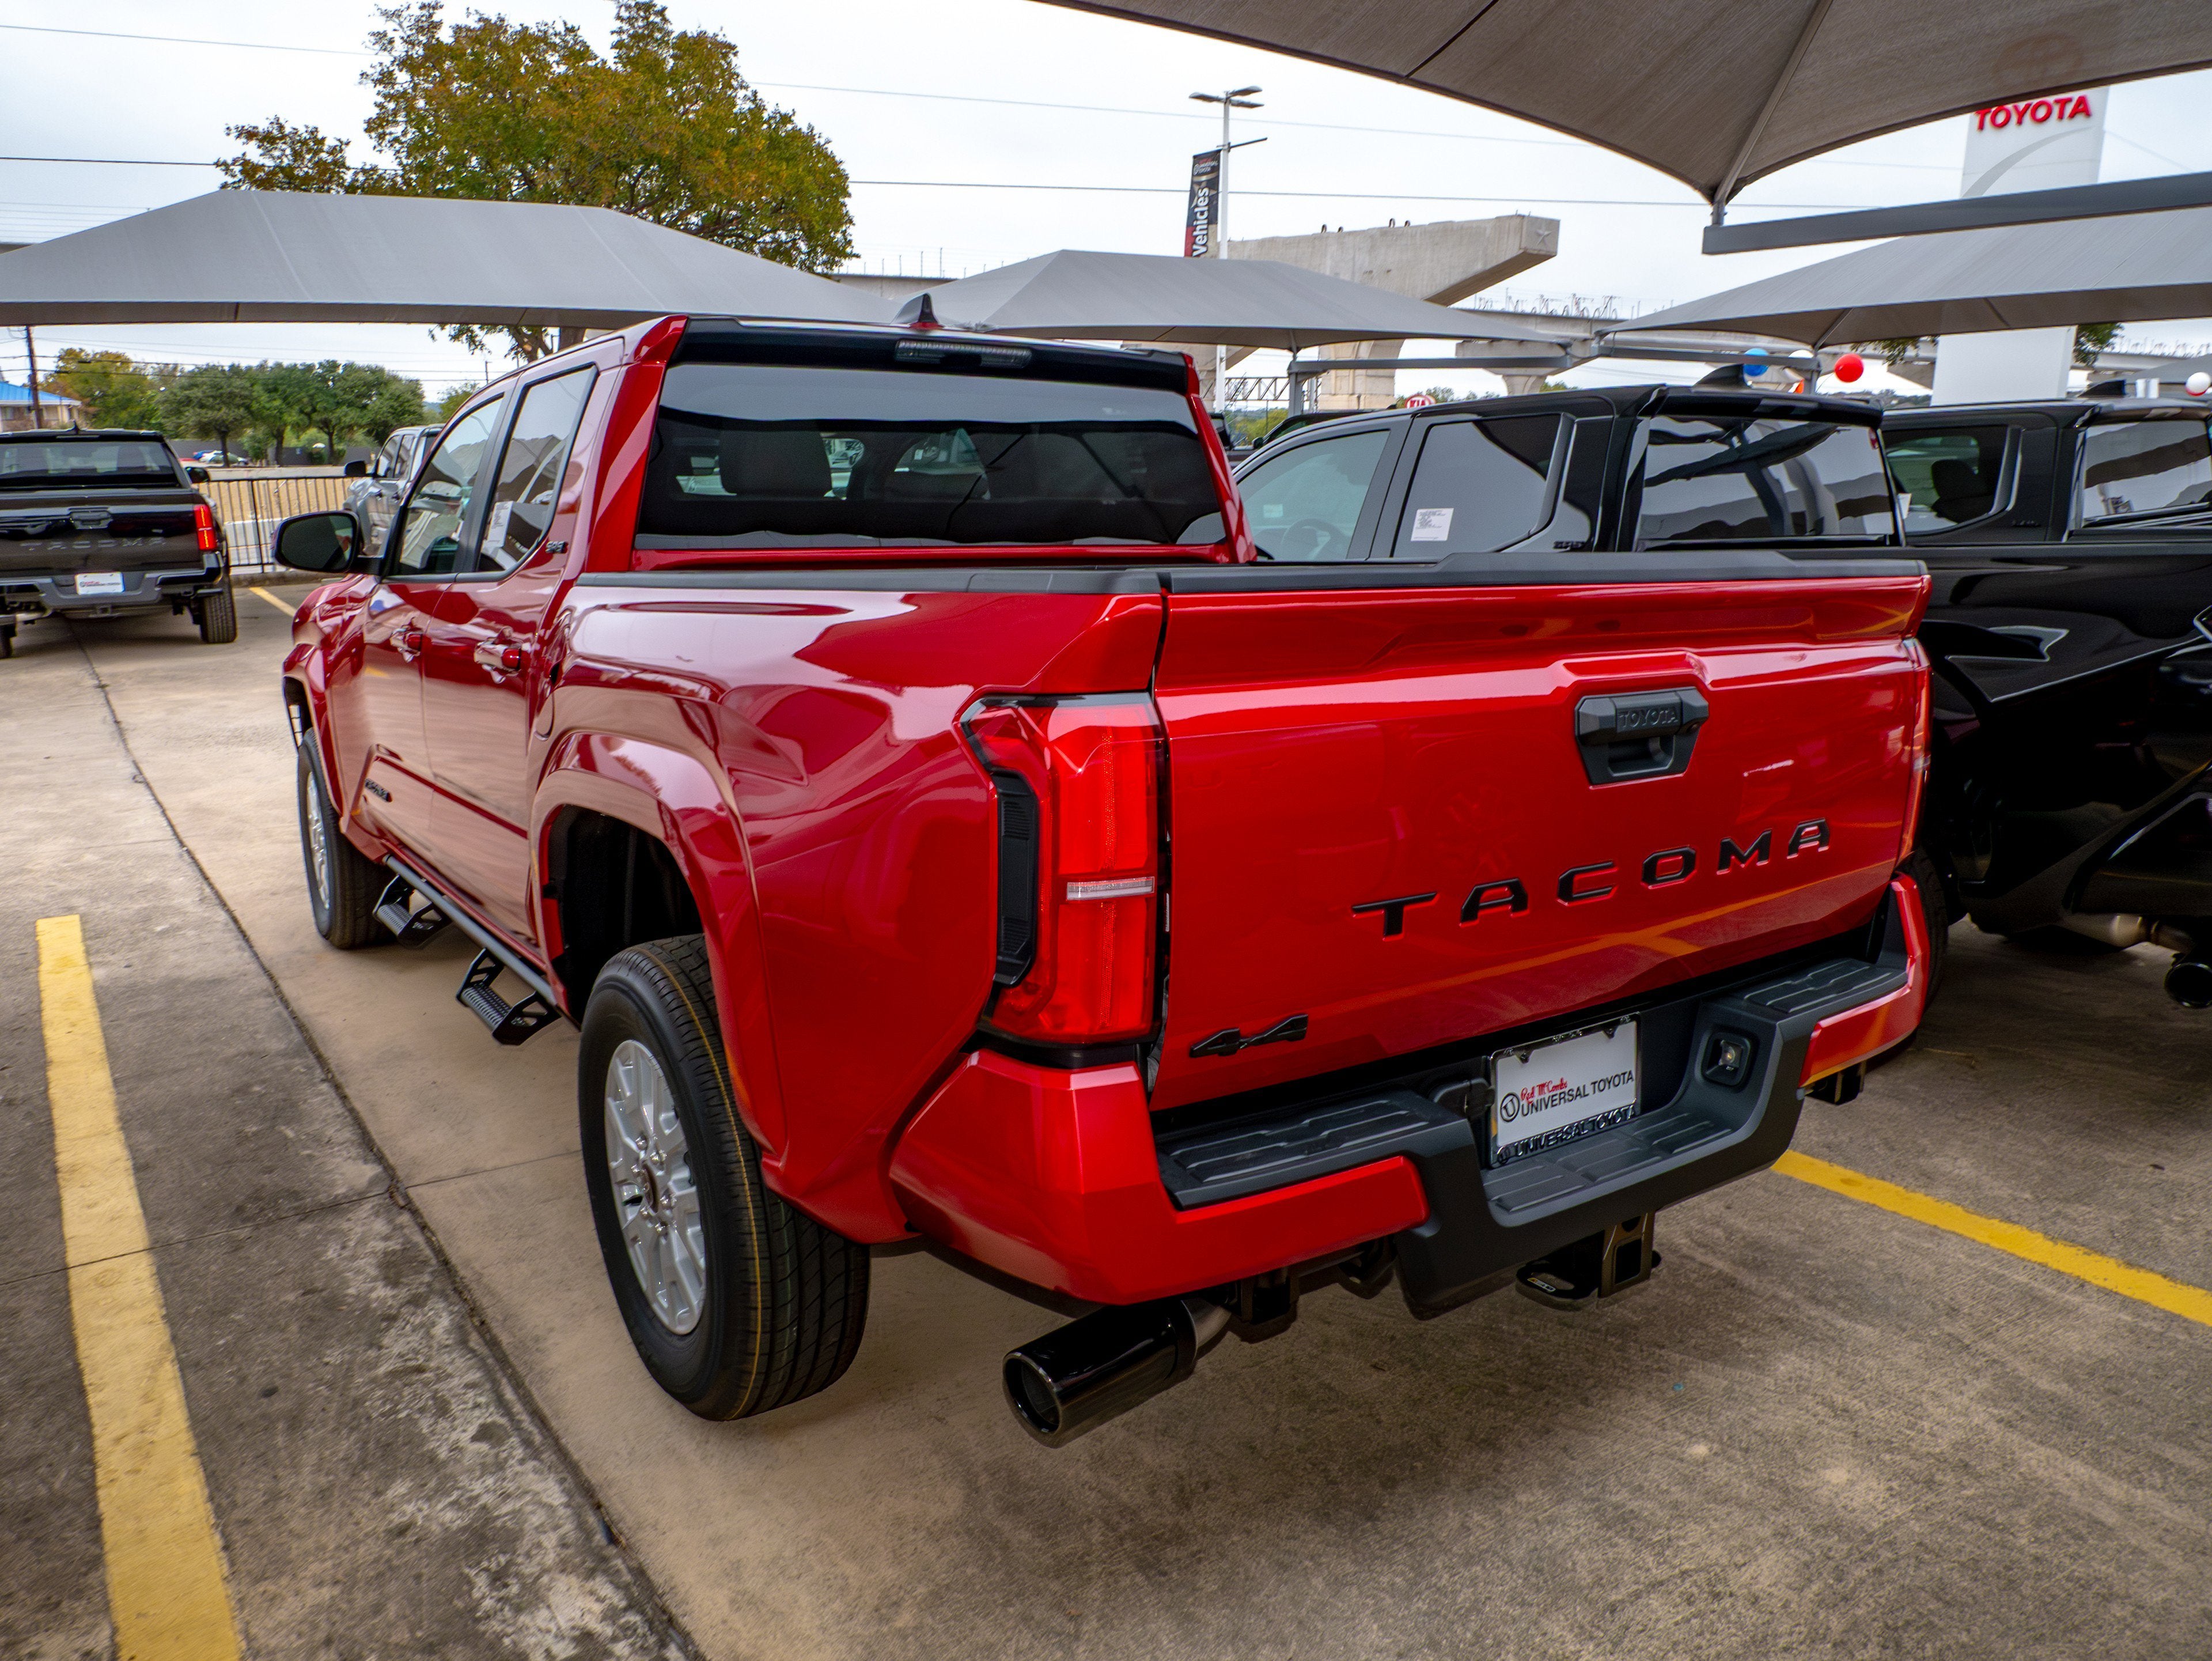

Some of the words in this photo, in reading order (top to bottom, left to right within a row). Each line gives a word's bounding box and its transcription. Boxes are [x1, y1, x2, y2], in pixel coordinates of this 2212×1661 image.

[1975, 94, 2092, 131] TOYOTA
[1192, 187, 1210, 258] Vehicles
[1618, 706, 1679, 728] TOYOTA
[1351, 817, 1831, 940] TACOMA
[1521, 1084, 1589, 1117] UNIVERSAL
[1590, 1069, 1634, 1095] TOYOTA
[1514, 1121, 1588, 1156] UNIVERSAL
[1588, 1104, 1635, 1131] TOYOTA
